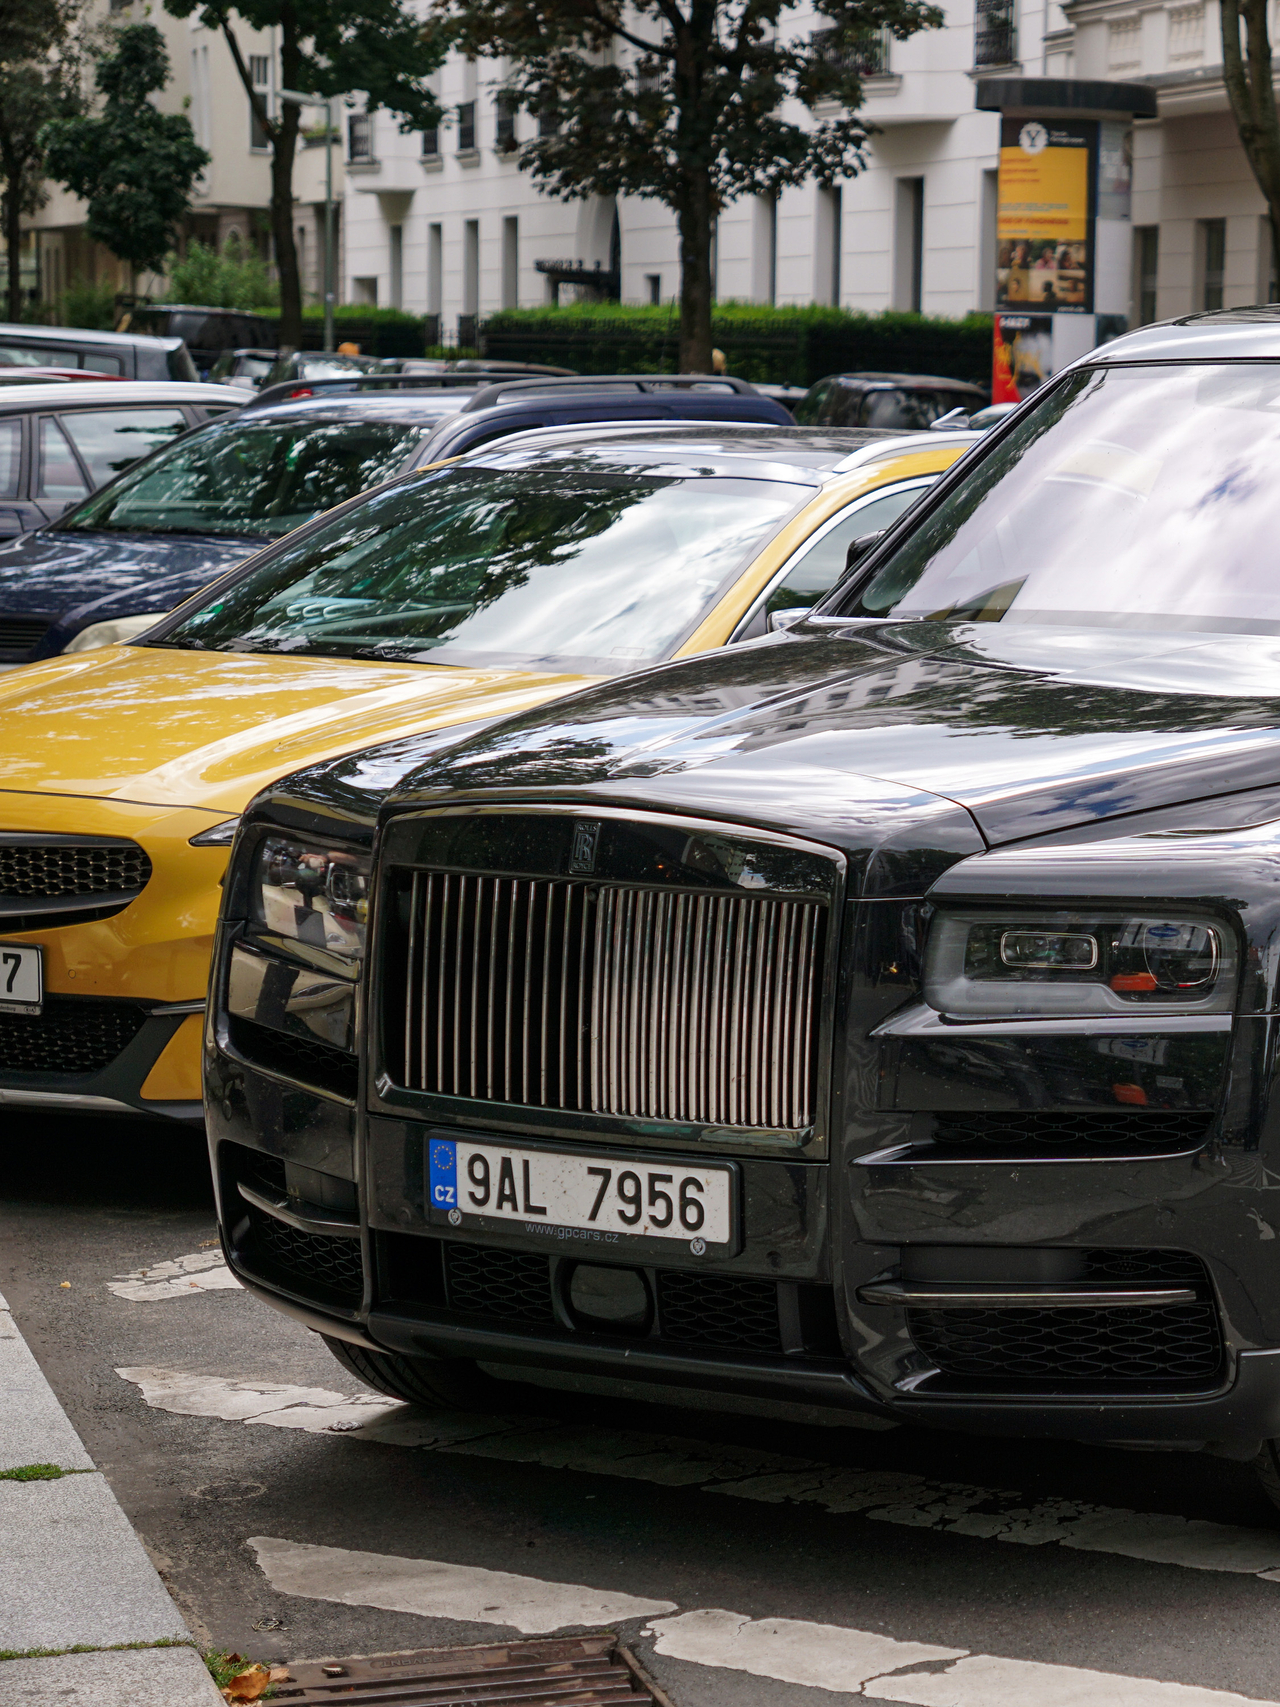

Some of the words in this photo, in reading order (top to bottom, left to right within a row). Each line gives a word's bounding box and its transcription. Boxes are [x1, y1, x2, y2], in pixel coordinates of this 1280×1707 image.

[1025, 130, 1042, 147] Y
[3, 953, 21, 993] 7
[434, 1185, 454, 1204] CZ
[467, 1153, 547, 1216] 9AL
[587, 1166, 706, 1232] 7956
[524, 1223, 620, 1243] www.gpcars.cz
